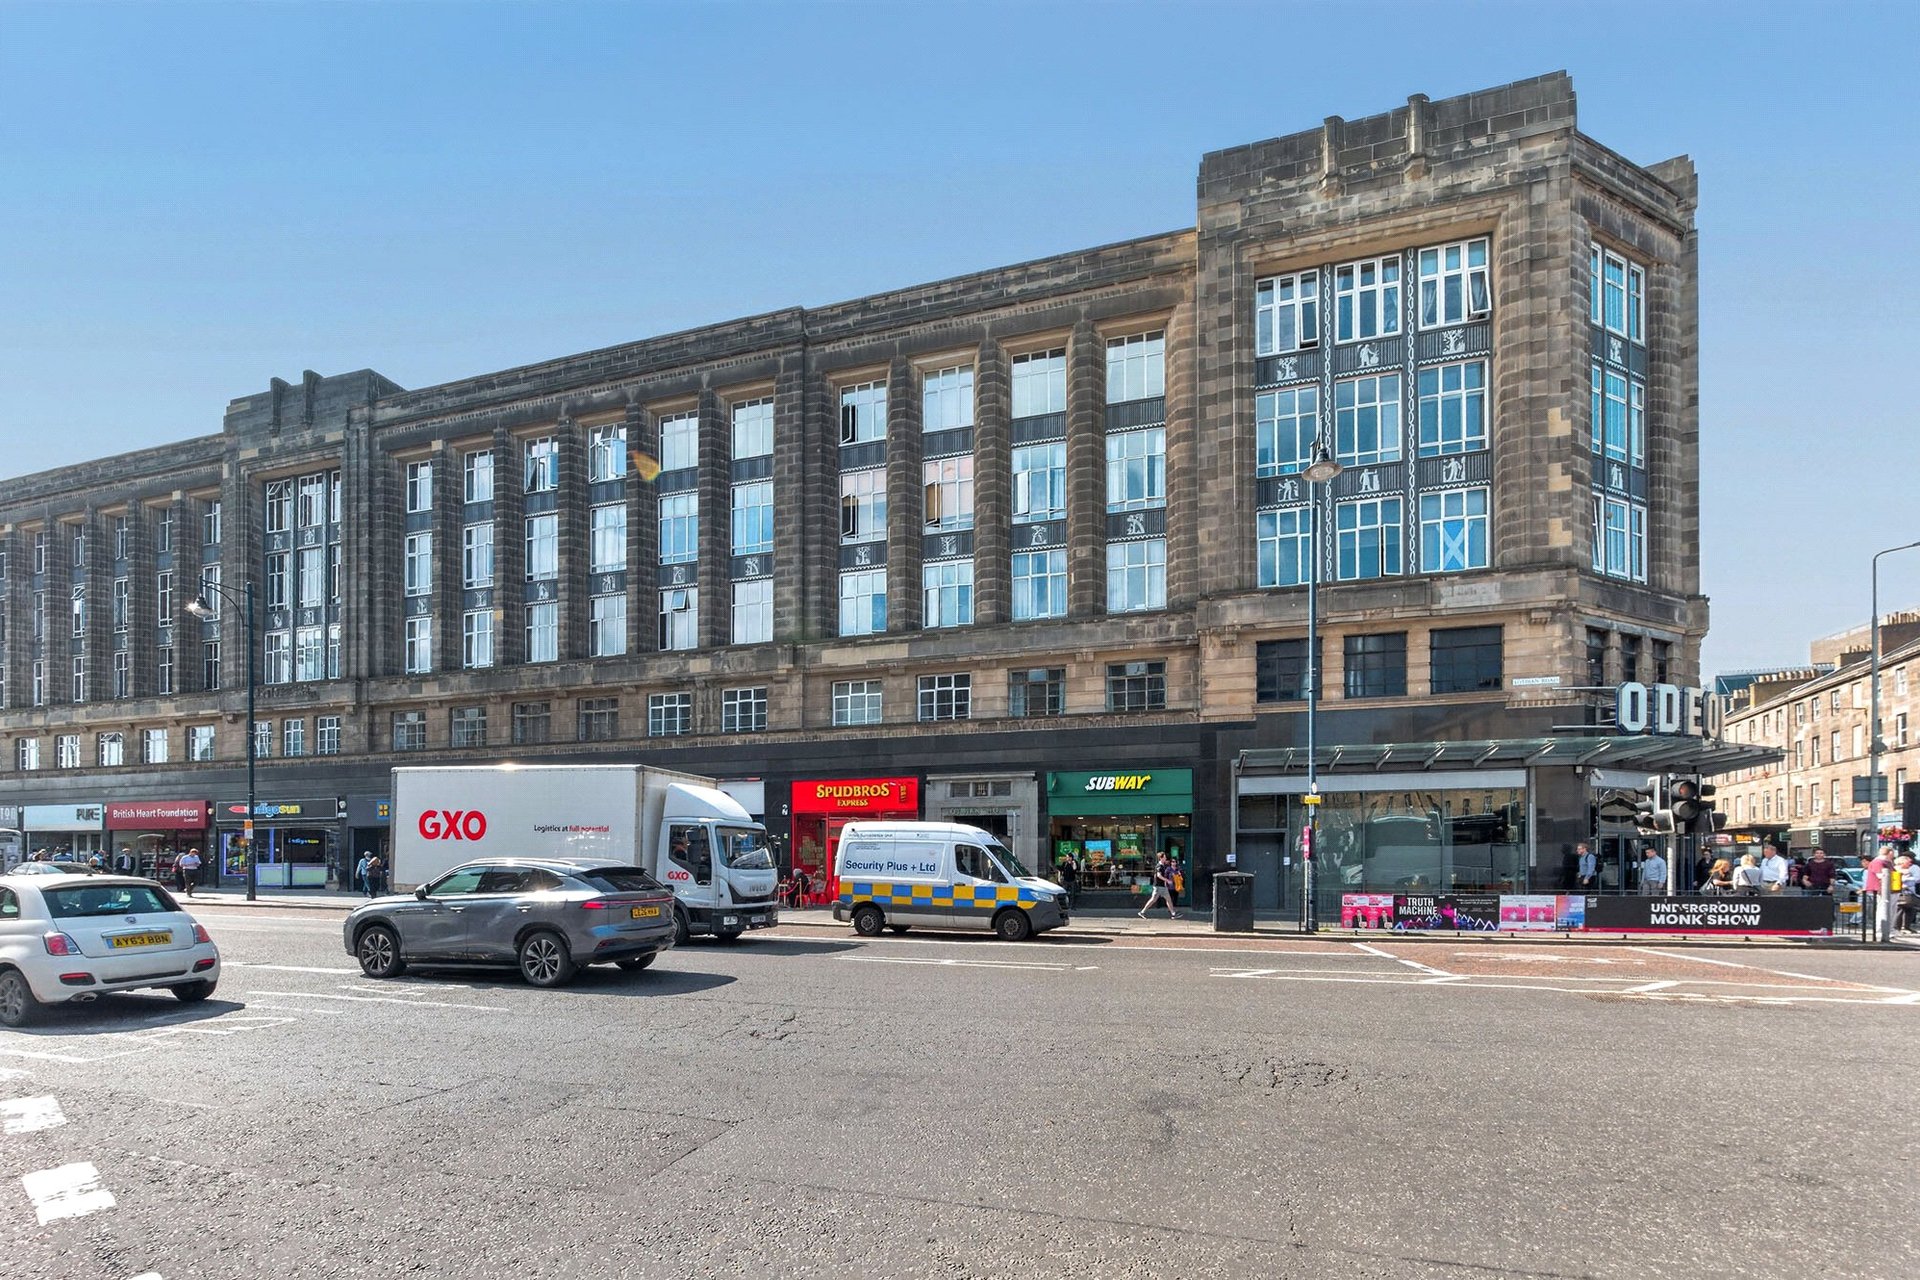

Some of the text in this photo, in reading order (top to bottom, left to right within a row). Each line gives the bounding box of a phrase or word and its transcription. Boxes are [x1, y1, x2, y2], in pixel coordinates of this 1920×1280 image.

[1615, 681, 1724, 740] ODEO
[1085, 774, 1151, 791] SUBWAY
[816, 782, 890, 798] SPUDBROS
[837, 799, 868, 807] EXPRESS
[76, 807, 100, 821] PURE
[113, 808, 198, 818] British Heart Foundation
[254, 802, 301, 818] digosun
[418, 809, 488, 842] GXO
[533, 825, 561, 833] Logistics
[845, 860, 884, 872] Security
[886, 861, 908, 871] Plus
[919, 862, 936, 872] Ltd
[667, 870, 690, 881] GXO
[1406, 897, 1434, 907] TRUTH
[1650, 902, 1761, 914] UNDERGROUND
[1398, 906, 1438, 916] MACHINE
[1650, 914, 1760, 926] MONK SHOW
